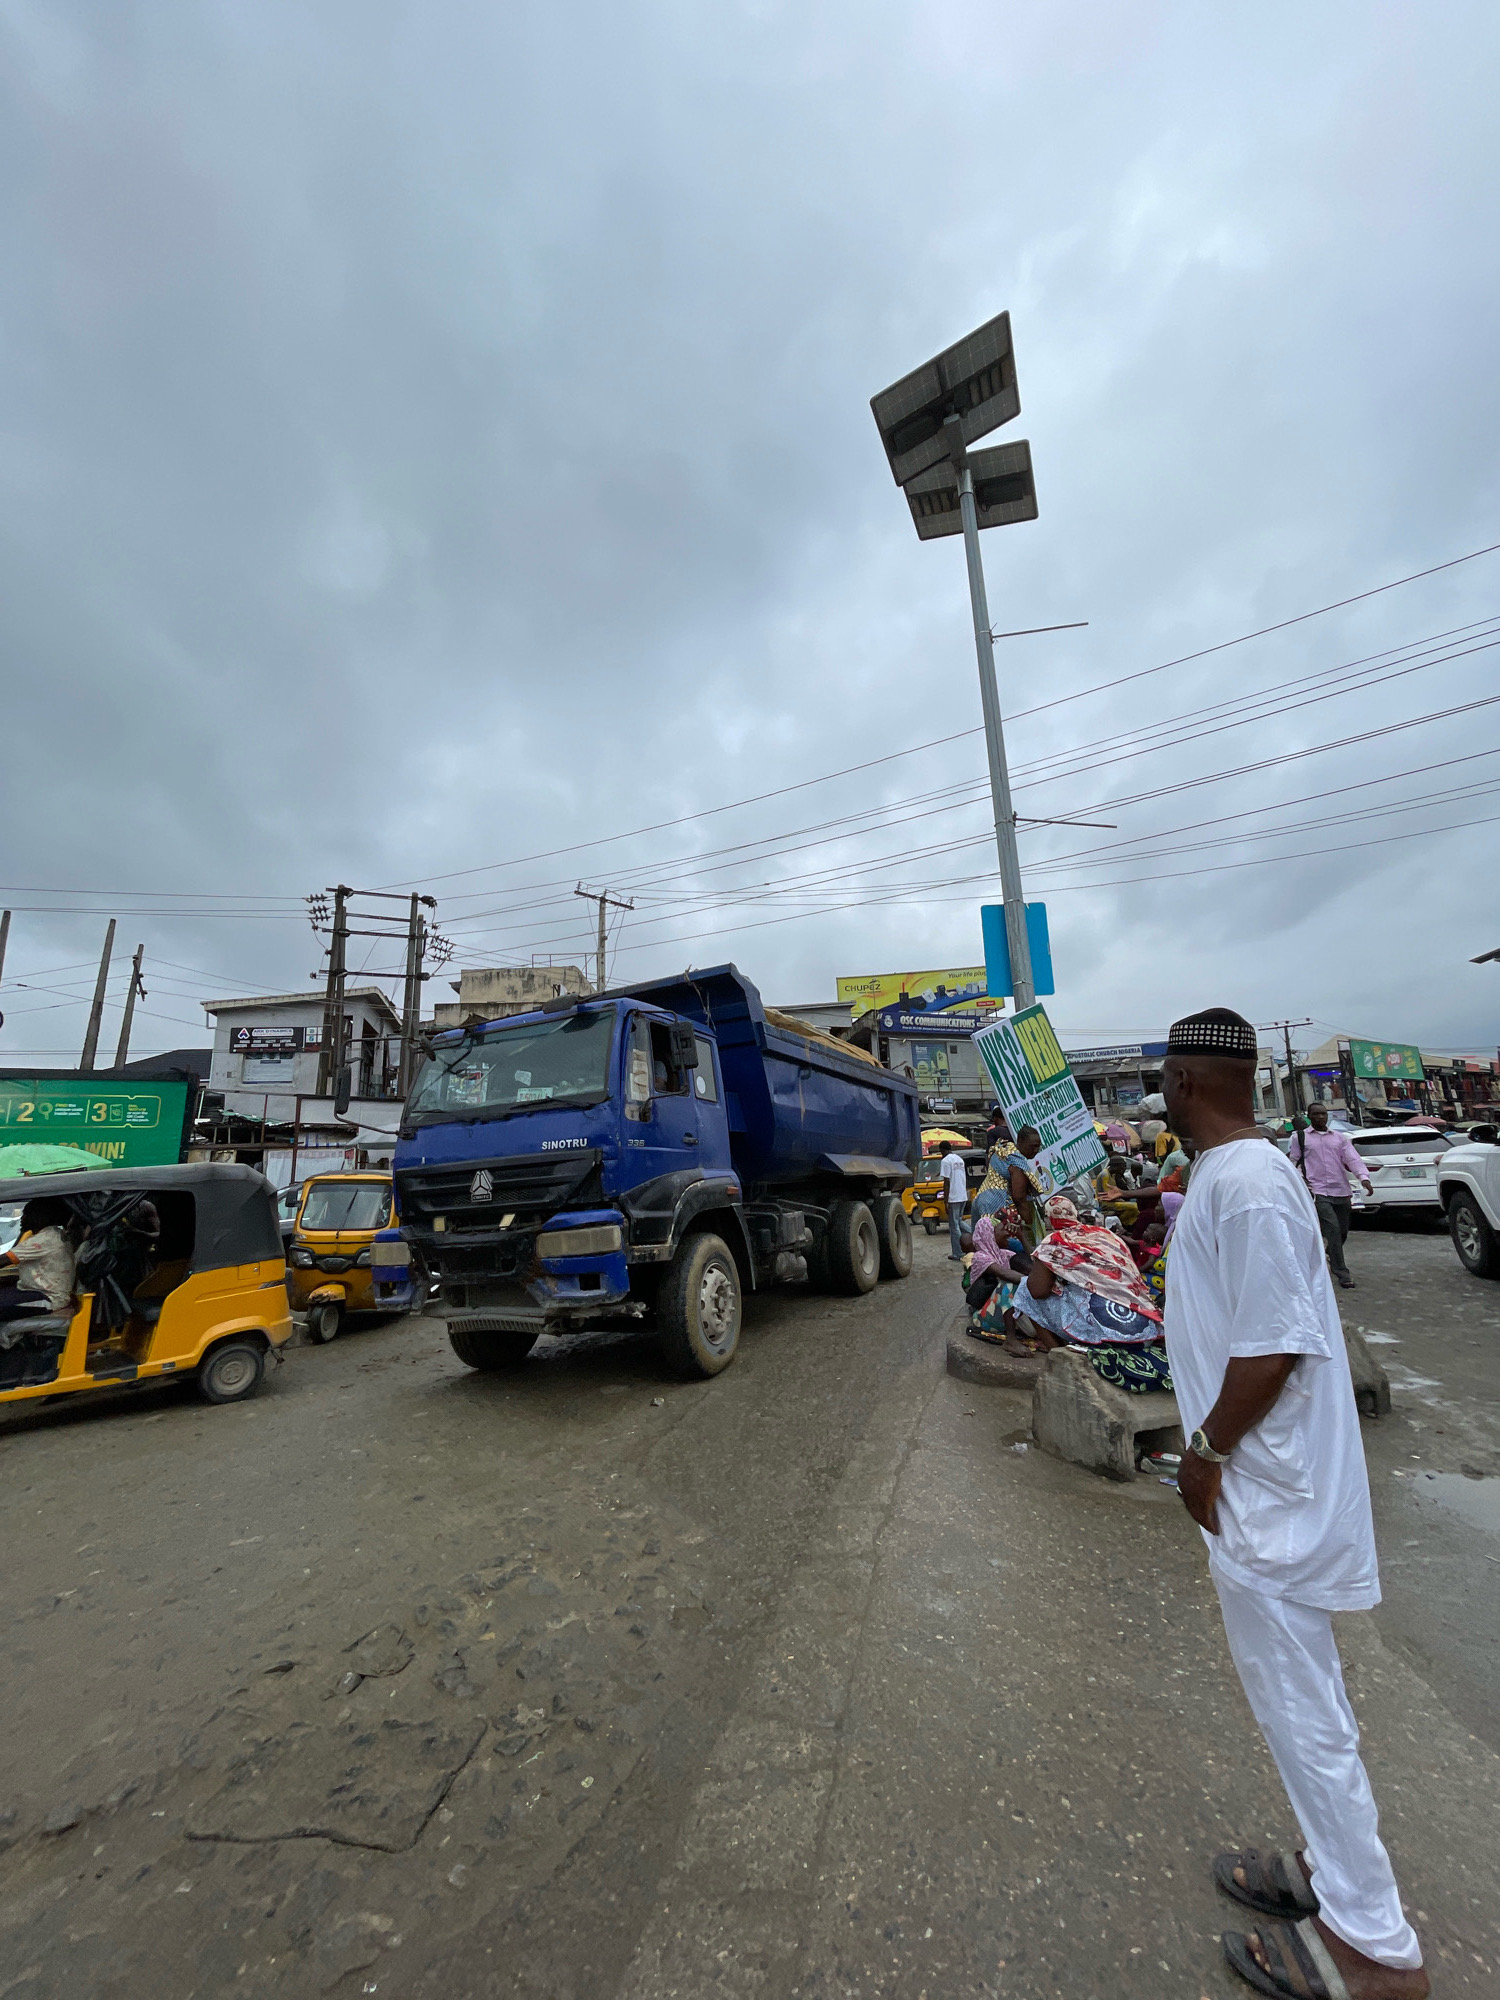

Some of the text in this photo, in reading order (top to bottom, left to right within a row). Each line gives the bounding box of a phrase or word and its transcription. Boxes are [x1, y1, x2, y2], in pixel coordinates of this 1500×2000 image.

[915, 1016, 976, 1028] COMMUNICATIONS
[976, 1012, 1066, 1109] NYSC NERD
[1096, 1049, 1118, 1057] CHURCH
[1118, 1047, 1141, 1055] NIGERIA
[16, 1102, 35, 1122] 2
[91, 1102, 107, 1122] 3
[1008, 1101, 1037, 1133] ONLINE
[1031, 1078, 1079, 1122] REGISTRATION
[541, 1138, 588, 1150] SINOTRU
[1038, 1118, 1063, 1151] ABLE
[85, 1142, 125, 1159] WIN!
